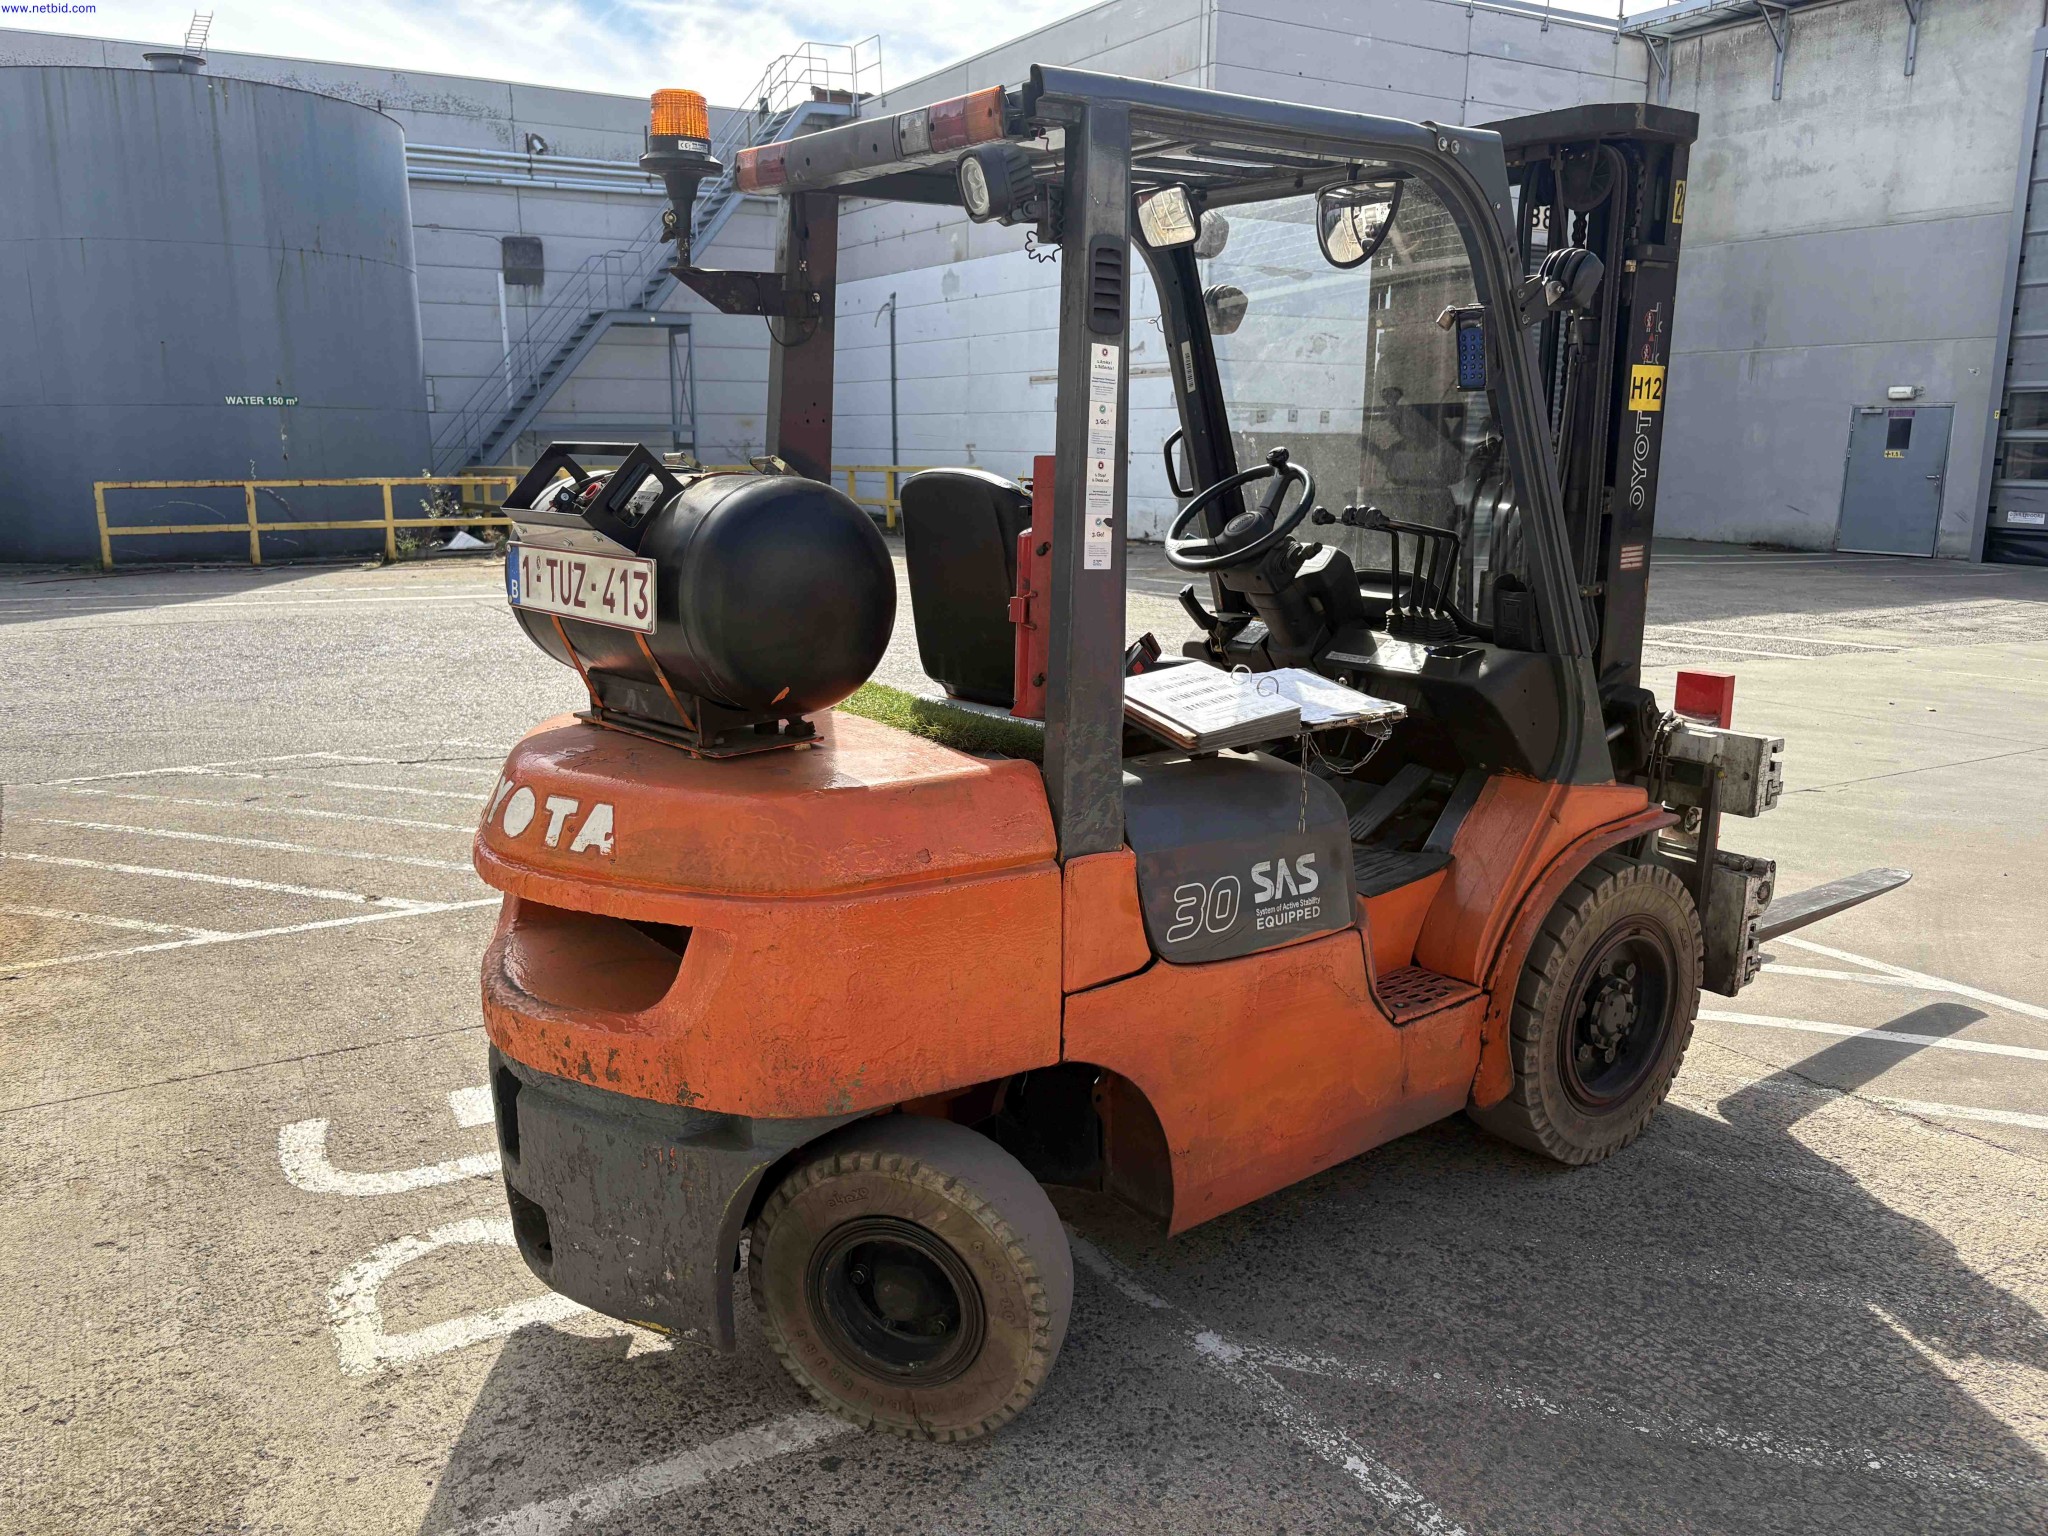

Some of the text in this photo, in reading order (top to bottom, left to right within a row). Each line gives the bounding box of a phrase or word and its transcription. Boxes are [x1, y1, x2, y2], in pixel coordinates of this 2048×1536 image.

[1674, 183, 1684, 220] 2
[225, 396, 265, 405] WATER
[266, 396, 284, 405] 150
[1630, 376, 1662, 401] H12
[511, 579, 519, 598] B
[1251, 853, 1319, 903] SAS
[1166, 875, 1241, 943] 30
[1255, 905, 1276, 917] System
[1283, 901, 1299, 910] Active
[1300, 896, 1320, 907] Stability
[1256, 905, 1321, 930] EQUIPPED
